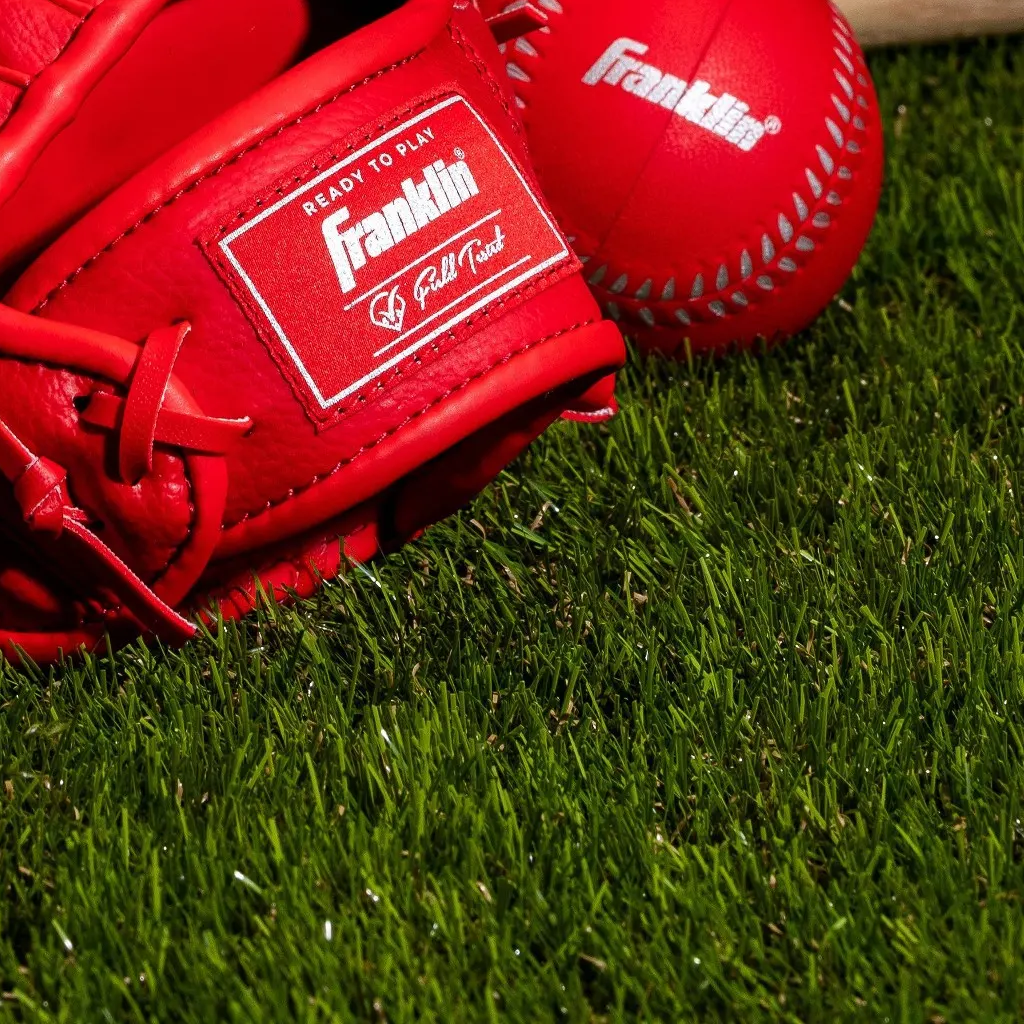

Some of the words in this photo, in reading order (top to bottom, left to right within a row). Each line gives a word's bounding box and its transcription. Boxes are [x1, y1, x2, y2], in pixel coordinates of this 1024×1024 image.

[580, 36, 766, 152] Franklin
[301, 168, 365, 217] READY
[367, 152, 394, 173] TO
[395, 126, 436, 157] PLAY
